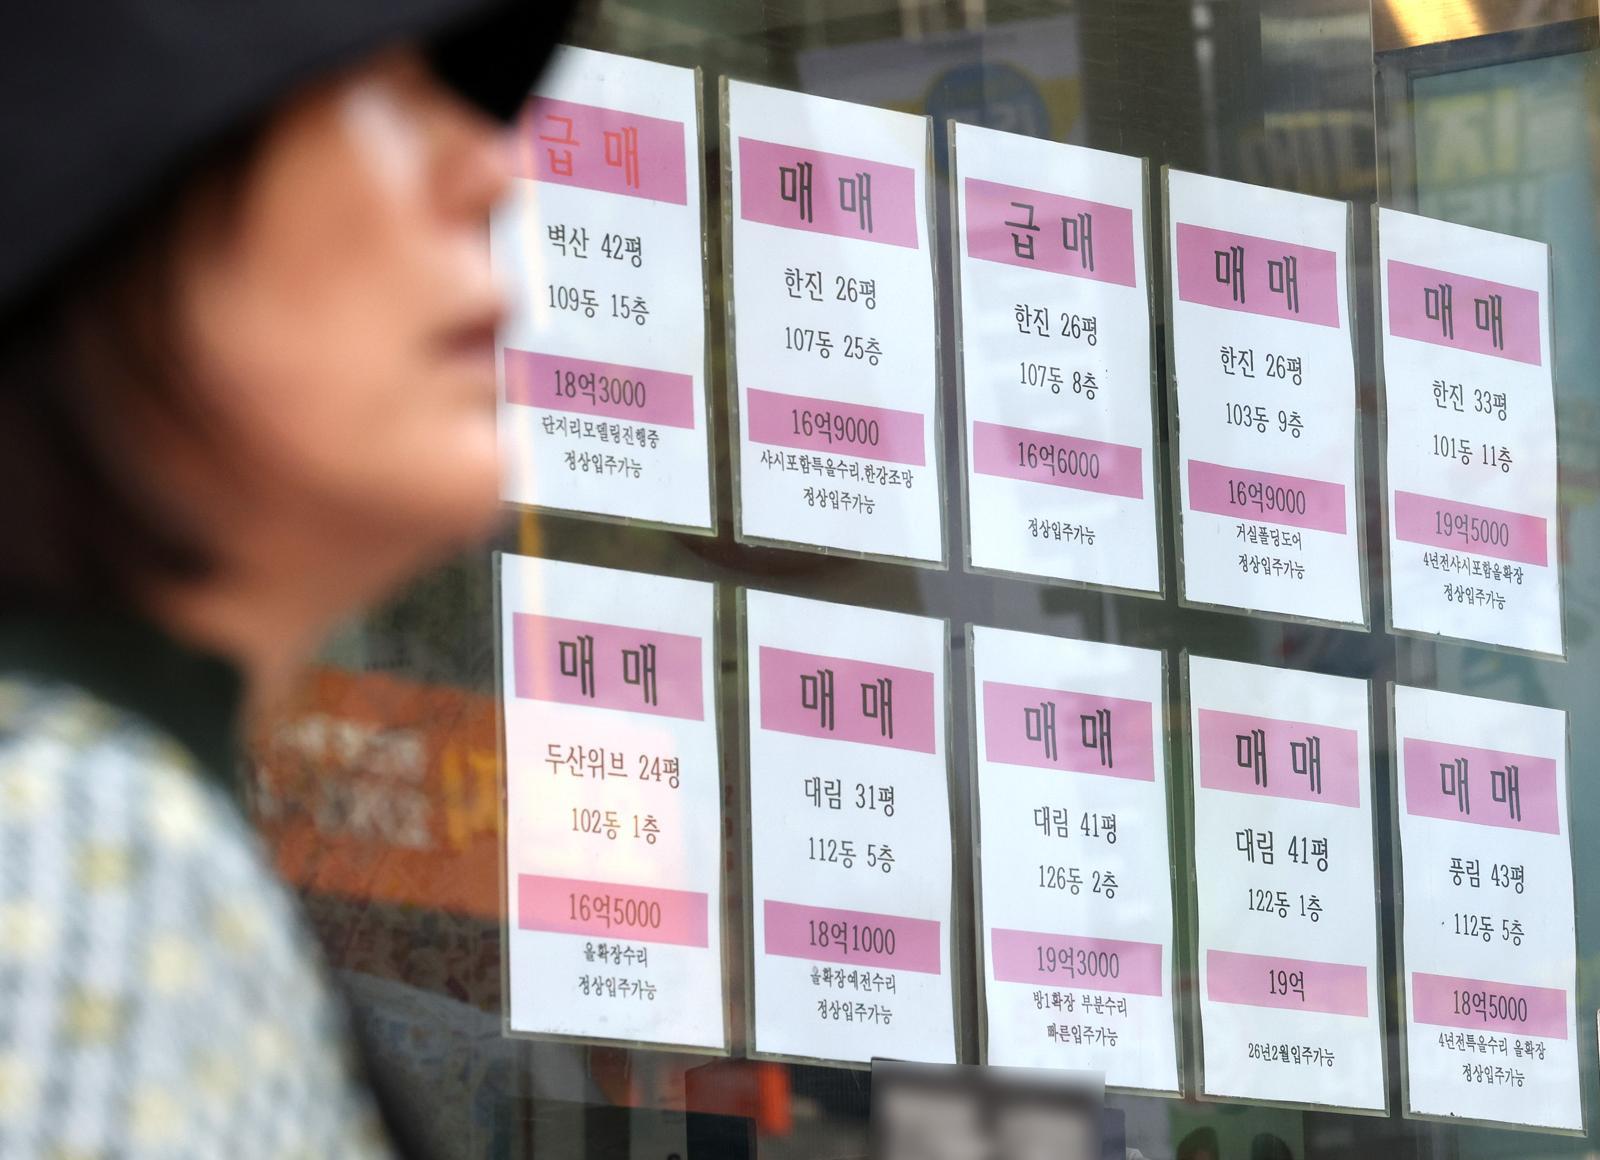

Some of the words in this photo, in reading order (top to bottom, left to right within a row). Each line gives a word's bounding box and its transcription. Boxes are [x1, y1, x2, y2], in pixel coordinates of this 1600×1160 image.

[540, 114, 579, 176] 급
[603, 127, 639, 188] 매
[779, 162, 813, 223] 매
[838, 172, 873, 233] 매
[548, 224, 589, 258] 벽산
[601, 233, 642, 268] 42평
[1005, 202, 1040, 260] 급
[1061, 213, 1094, 272] 매
[785, 268, 823, 301] 한진
[836, 276, 876, 310] 26평
[1214, 246, 1245, 304] 매
[1267, 256, 1299, 313] 매
[549, 285, 599, 318] 109동
[612, 294, 649, 325] 15층
[1424, 283, 1453, 340] 매
[1474, 294, 1503, 350] 매
[1015, 304, 1050, 337] 한진
[1061, 313, 1097, 346] 26평
[786, 327, 833, 359] 107동
[844, 335, 882, 366] 25층
[1021, 362, 1063, 394] 107동
[1073, 371, 1098, 400] 8층
[1220, 346, 1255, 378] 한진
[1266, 354, 1302, 385] 26평
[554, 366, 646, 411] 18억3000
[1433, 380, 1464, 412] 한진
[1474, 389, 1507, 421] 33평
[542, 416, 659, 449] 단지리모델링진행중
[792, 409, 879, 449] 16억9000
[1227, 403, 1269, 433] 103동
[1278, 411, 1303, 438] 9층
[565, 450, 642, 478] 정상입주가능
[1018, 442, 1099, 482] 16억6000
[1434, 435, 1473, 465] 101동
[1483, 444, 1512, 473] 11층
[804, 487, 875, 514] 정상입주가능
[1228, 480, 1305, 516] 16억9000
[1028, 518, 1095, 545] 정상입주가능
[1236, 523, 1301, 550] 거실폴딩도어
[1434, 509, 1510, 548] 19억5000
[1239, 554, 1305, 579] 정상입주가능
[1424, 551, 1523, 585] 4년전샤시포함올확장
[1444, 583, 1506, 610] 정상입주가능
[559, 635, 595, 698] 매
[622, 644, 657, 706] 매
[800, 669, 834, 731] 매
[861, 678, 893, 739] 매
[1024, 701, 1057, 761] 매
[1080, 708, 1112, 768] 매
[545, 744, 628, 780] 두산위브
[639, 755, 679, 789] 24평
[1236, 729, 1267, 788] 매
[1290, 736, 1321, 794] 매
[805, 777, 841, 809] 대림
[856, 784, 894, 817] 31평
[1440, 758, 1470, 815] 매
[1490, 765, 1521, 822] 매
[573, 808, 621, 840] 102동
[634, 815, 660, 844] 1층
[1034, 806, 1068, 838] 대림
[1081, 812, 1116, 844] 41평
[809, 837, 856, 868] 112동
[867, 844, 895, 873] 5층
[1236, 829, 1273, 864] 대림
[1288, 836, 1328, 872] 41평
[1040, 865, 1083, 895] 126동
[1093, 871, 1118, 899] 2층
[1449, 858, 1480, 888] 풍림
[1491, 864, 1524, 894] 43평
[570, 893, 661, 928] 16억5000
[1249, 889, 1290, 918] 122동
[1300, 895, 1323, 922] 1층
[810, 920, 895, 955] 18억1000
[1455, 913, 1494, 942] 112동
[1502, 920, 1524, 946] 5층
[584, 942, 647, 967] 올확장수리
[1038, 946, 1119, 979] 19억3000
[579, 975, 656, 1000] 정상입주가능
[810, 967, 895, 994] 올확장예전수리
[1270, 970, 1304, 1002] 19억
[818, 999, 892, 1024] 정상입주가능
[1033, 990, 1075, 1012] 방1확장
[1082, 995, 1127, 1017] 부분수리
[1454, 990, 1527, 1022] 18억5000
[1047, 1023, 1118, 1046] 빠른입주가능
[1439, 1032, 1507, 1056] 4년전특올수리
[1514, 1040, 1546, 1060] 올확장
[1249, 1043, 1335, 1067] 26년2월입주가능
[1463, 1063, 1525, 1087] 정상입주가능
